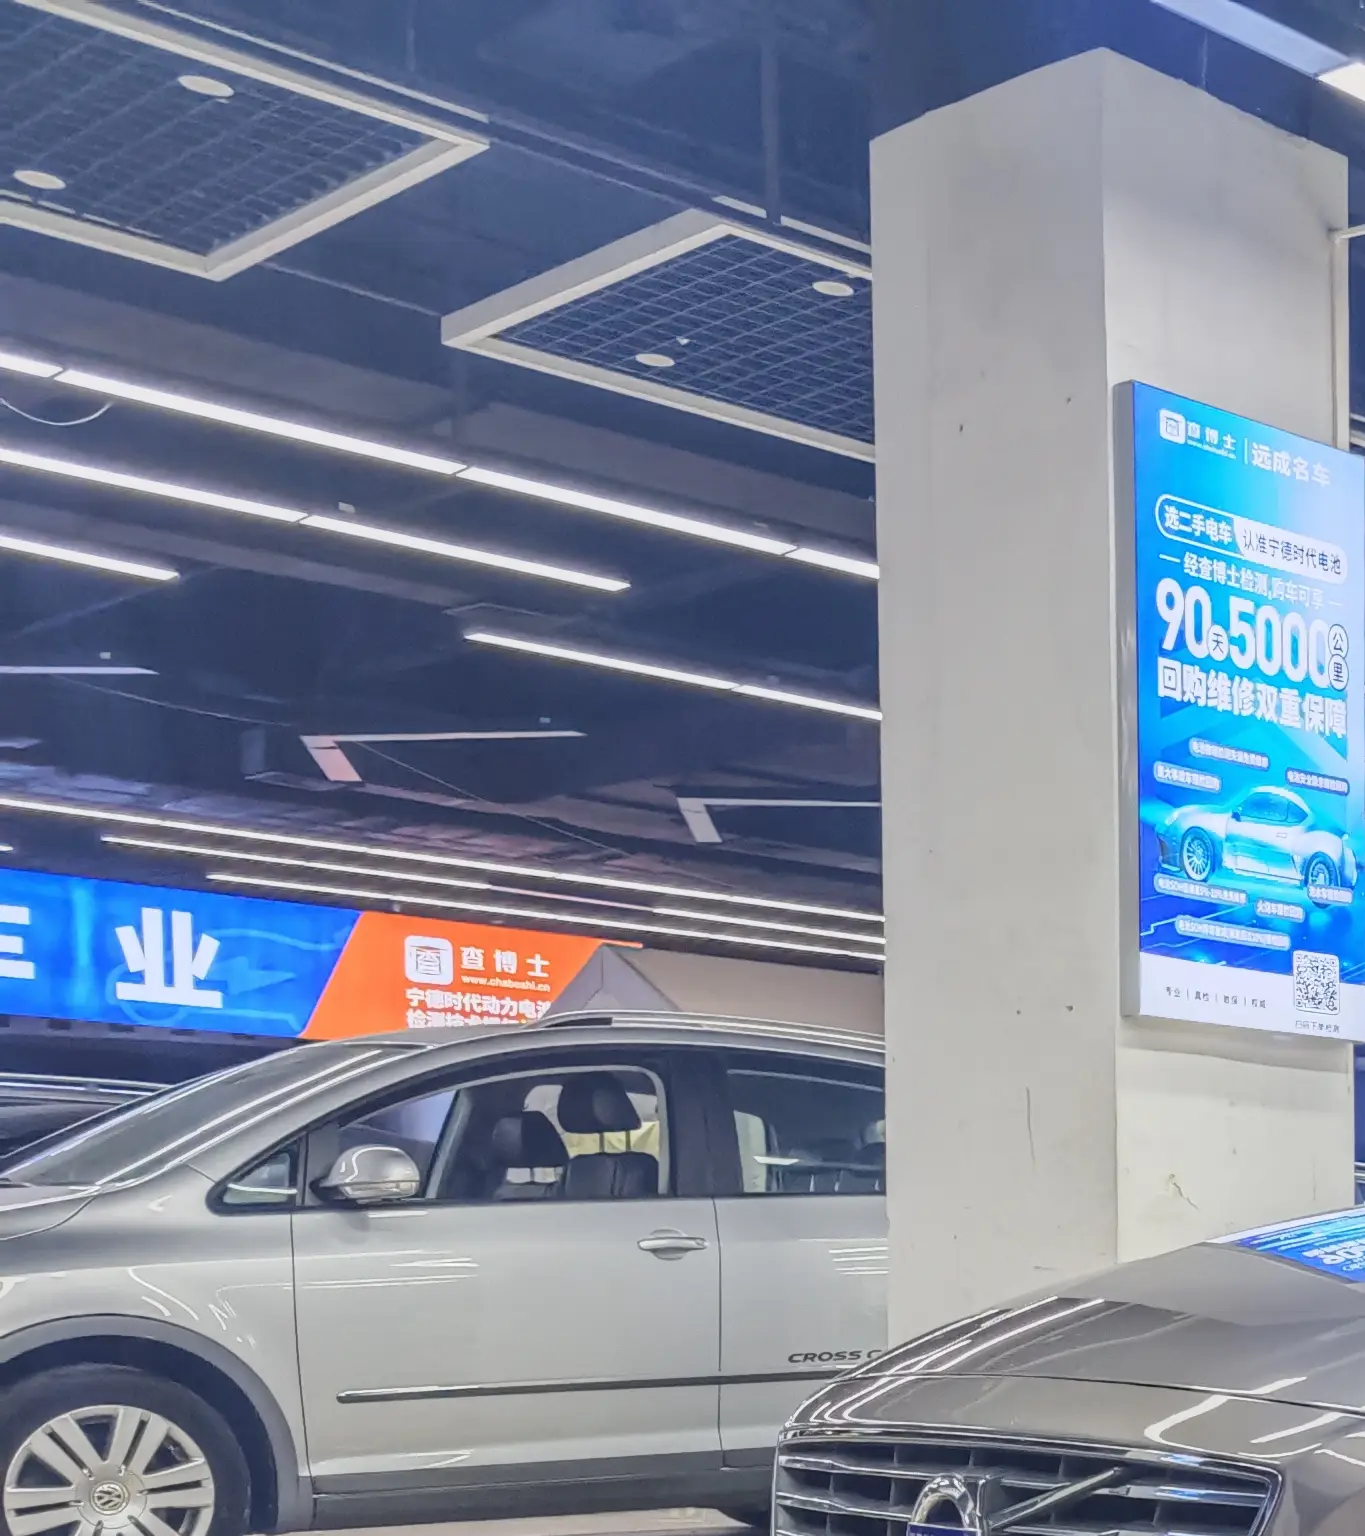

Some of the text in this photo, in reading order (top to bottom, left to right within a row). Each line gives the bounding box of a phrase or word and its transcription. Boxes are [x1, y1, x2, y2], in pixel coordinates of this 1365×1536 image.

[1252, 442, 1331, 487] 远成名车
[1164, 505, 1233, 545] 选二手电车
[1243, 529, 1342, 575] 认准宁德时代电池
[1157, 656, 1347, 739] 回购维修双重保障
[460, 946, 550, 978] 查博士
[787, 1350, 863, 1363] CROSS
